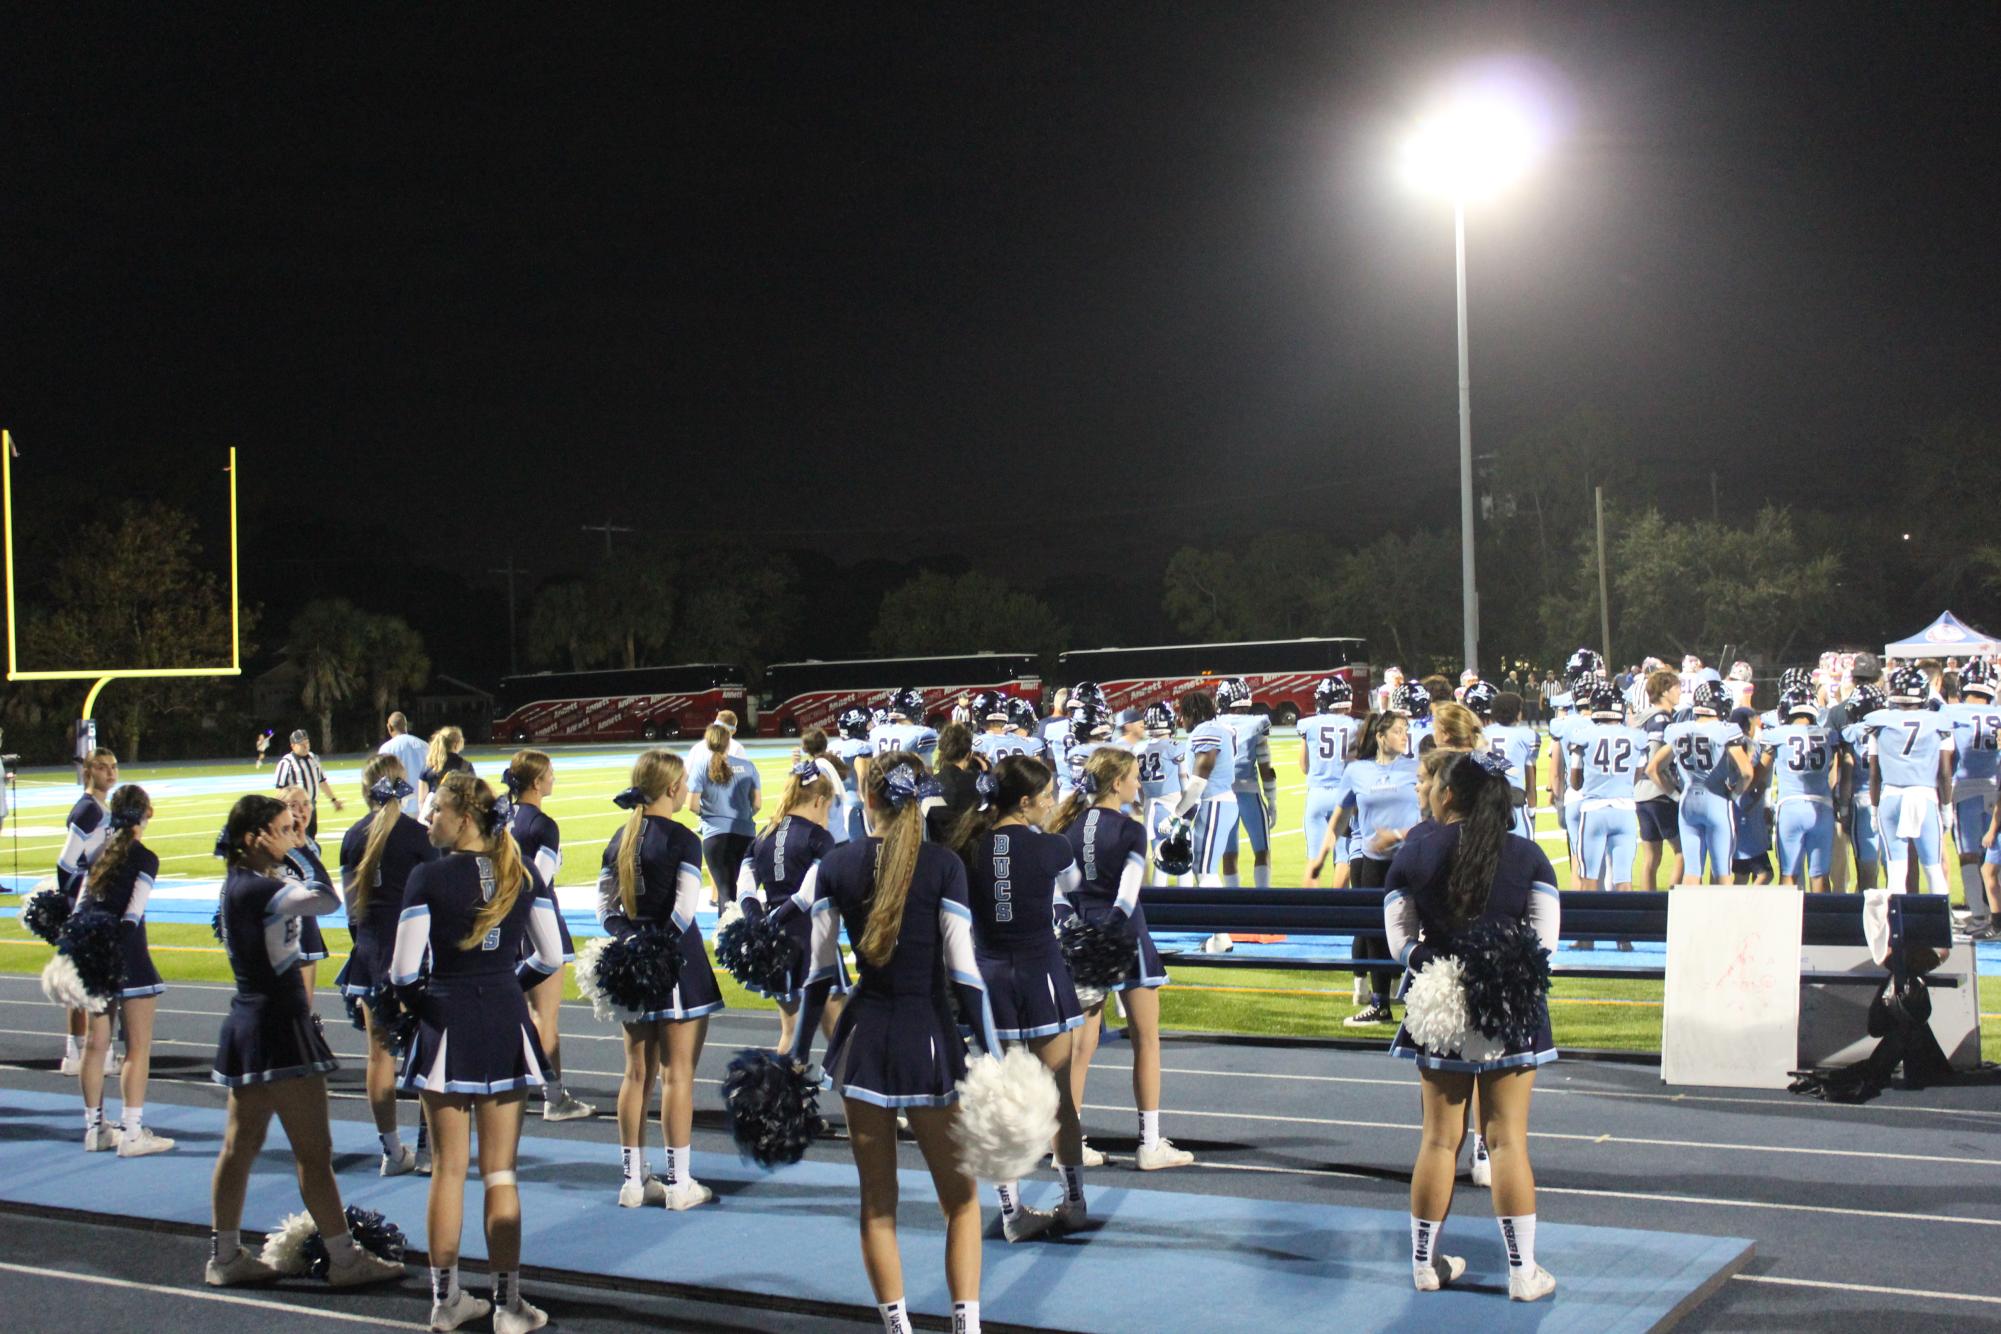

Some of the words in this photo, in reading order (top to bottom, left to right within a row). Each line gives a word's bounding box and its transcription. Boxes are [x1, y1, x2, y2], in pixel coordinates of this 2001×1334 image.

[1319, 727, 1348, 760] 51
[1593, 737, 1632, 774] 42
[1677, 736, 1713, 771] 25
[1788, 736, 1827, 771] 35
[1903, 721, 1921, 756] 7
[993, 834, 1013, 922] BUCS
[476, 856, 501, 951] BUS
